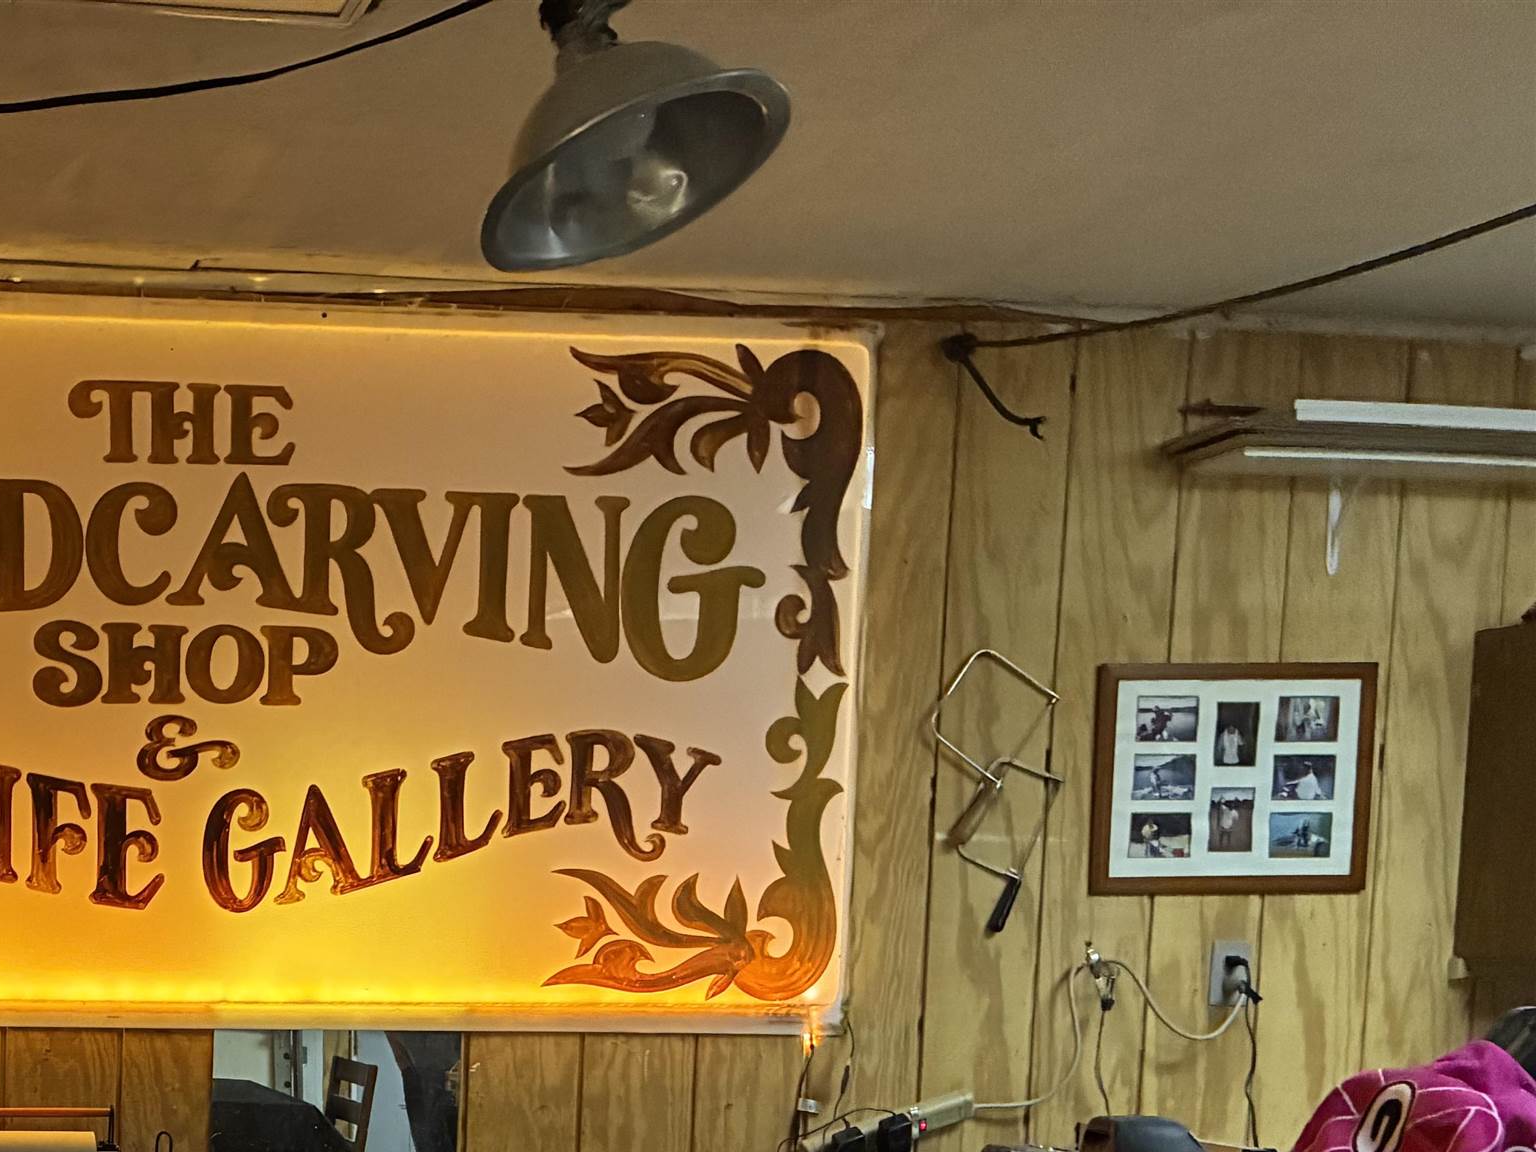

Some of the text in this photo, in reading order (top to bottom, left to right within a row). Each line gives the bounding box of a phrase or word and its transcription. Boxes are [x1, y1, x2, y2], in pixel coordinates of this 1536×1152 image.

[68, 379, 295, 466] THE
[33, 619, 338, 707] SHOP
[136, 715, 240, 781] &
[202, 729, 721, 913] GALLERY
